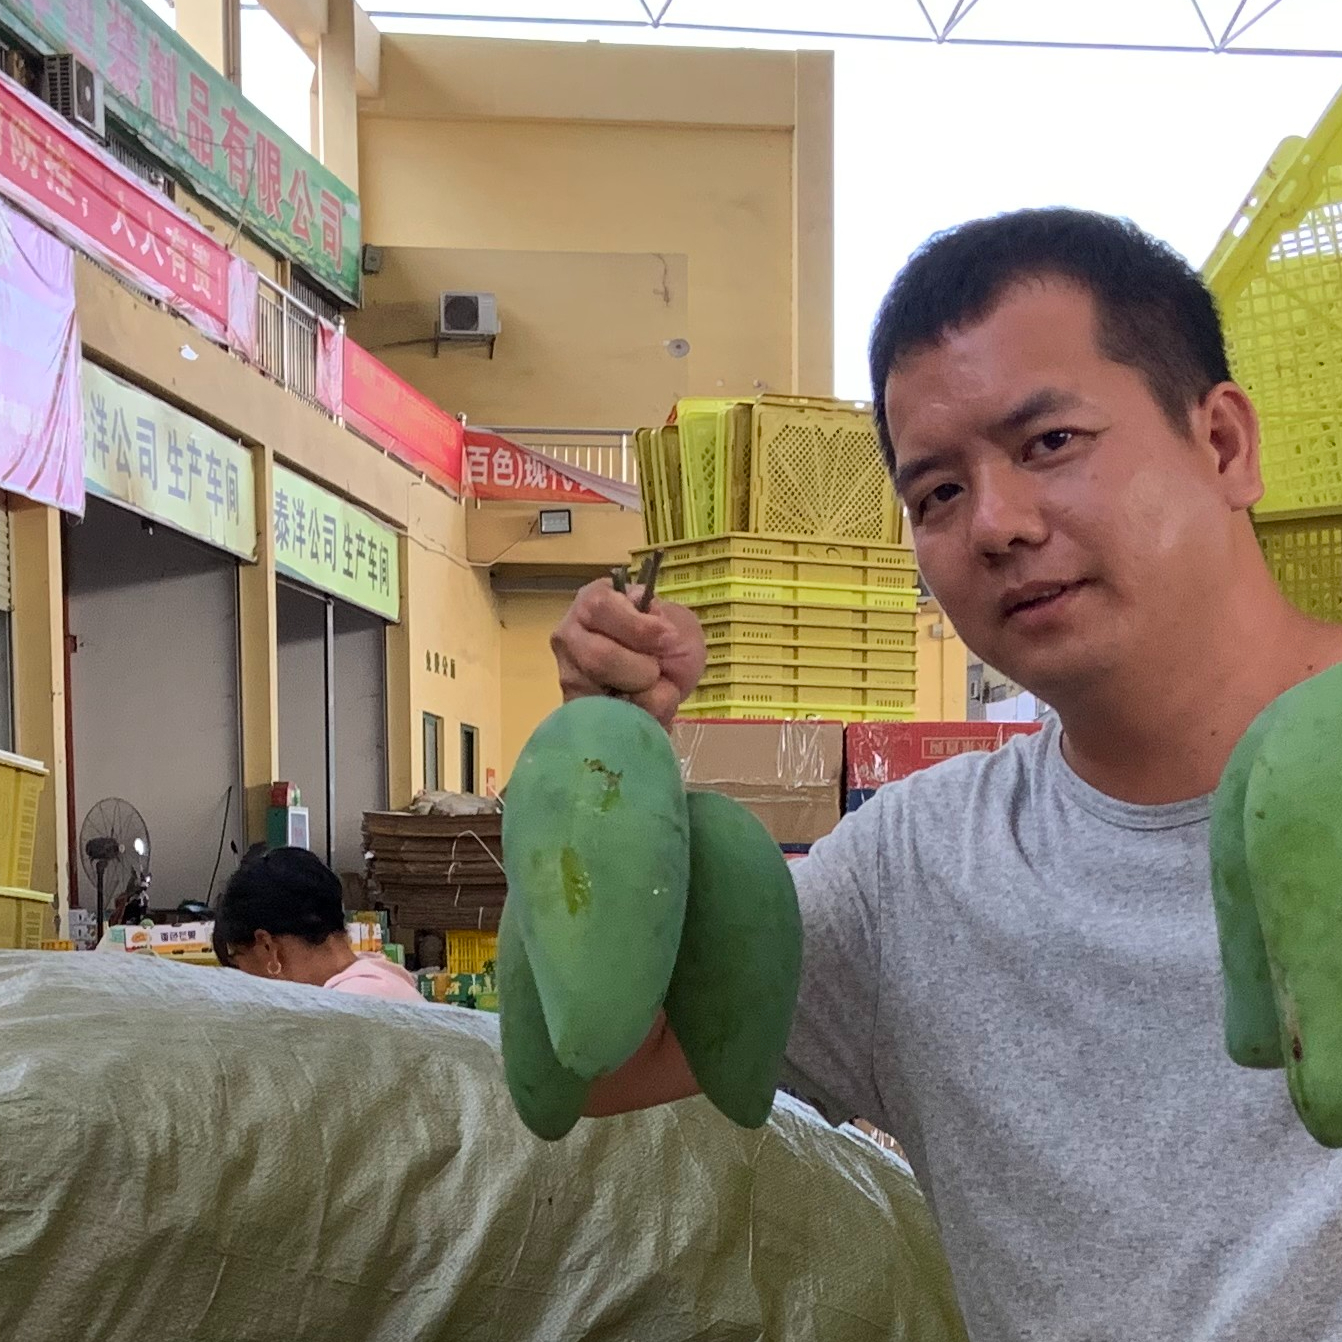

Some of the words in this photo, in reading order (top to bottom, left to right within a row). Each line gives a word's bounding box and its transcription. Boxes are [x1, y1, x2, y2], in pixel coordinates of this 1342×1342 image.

[84, 393, 157, 491] 洋公司
[167, 429, 240, 526] 生产车间
[274, 489, 338, 573] 泰洋公司
[342, 522, 390, 597] 生产车间
